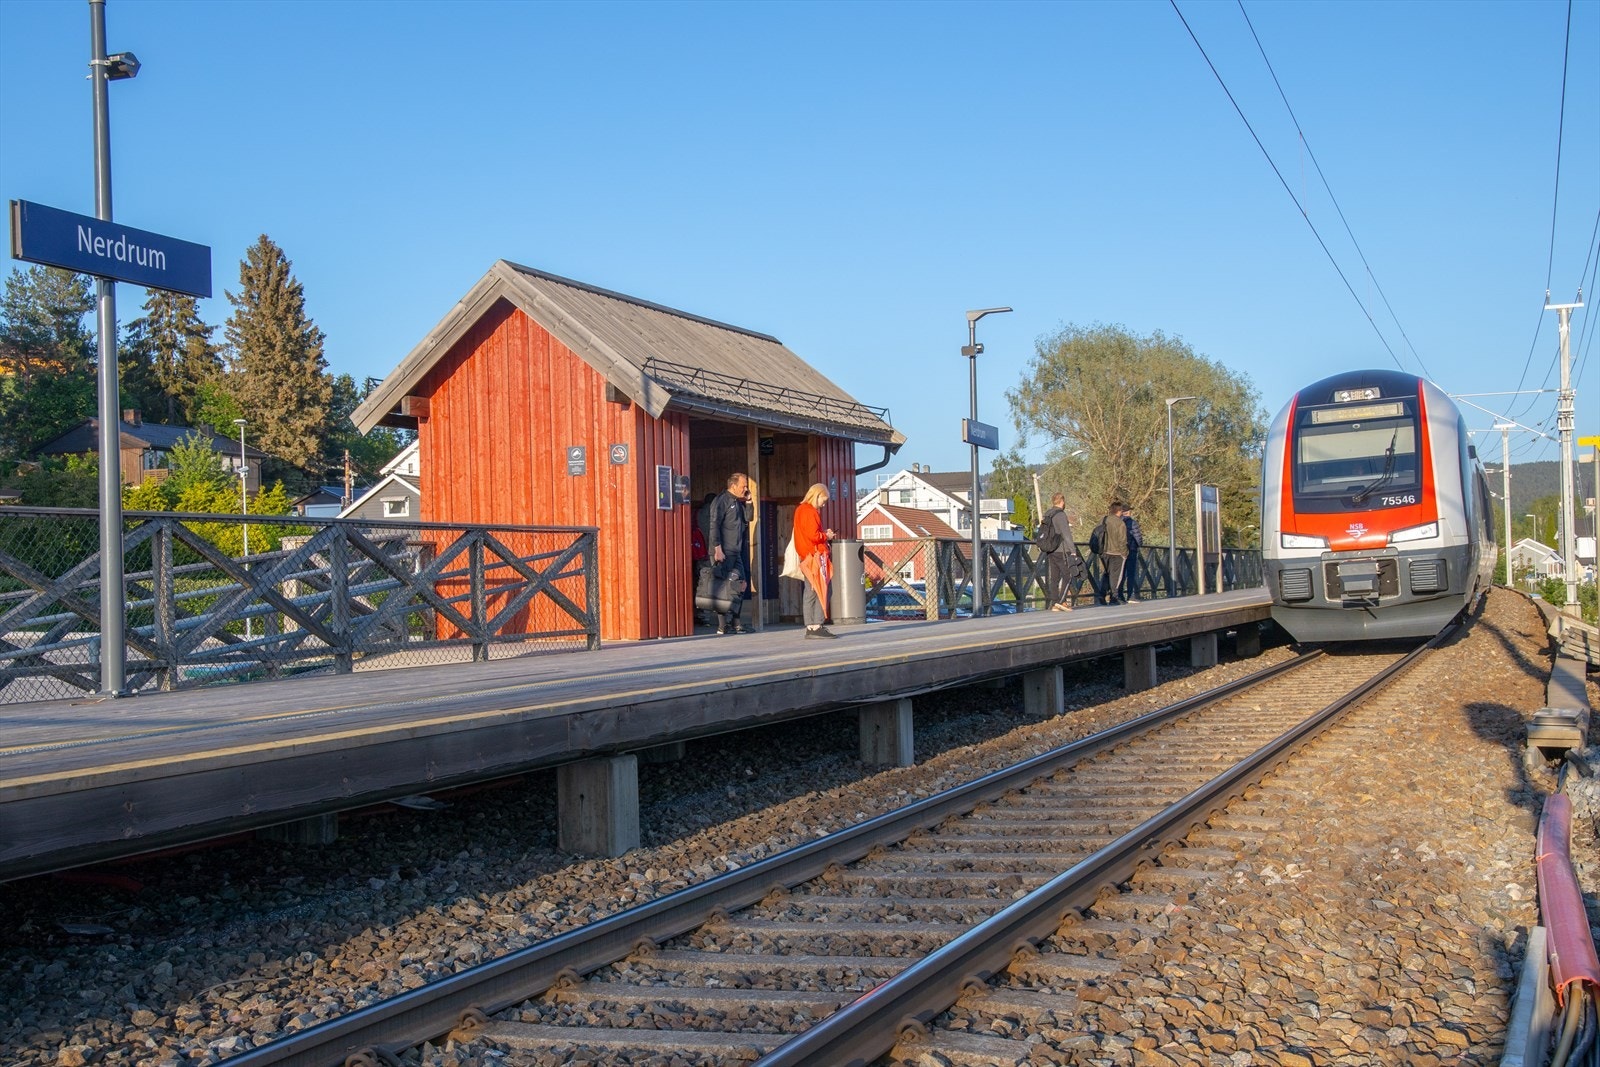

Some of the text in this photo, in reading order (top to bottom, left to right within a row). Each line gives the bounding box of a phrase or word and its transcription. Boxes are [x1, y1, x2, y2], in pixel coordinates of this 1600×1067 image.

[77, 224, 166, 271] Nerdrum
[1381, 494, 1416, 506] 75546
[1349, 522, 1364, 530] NSB
